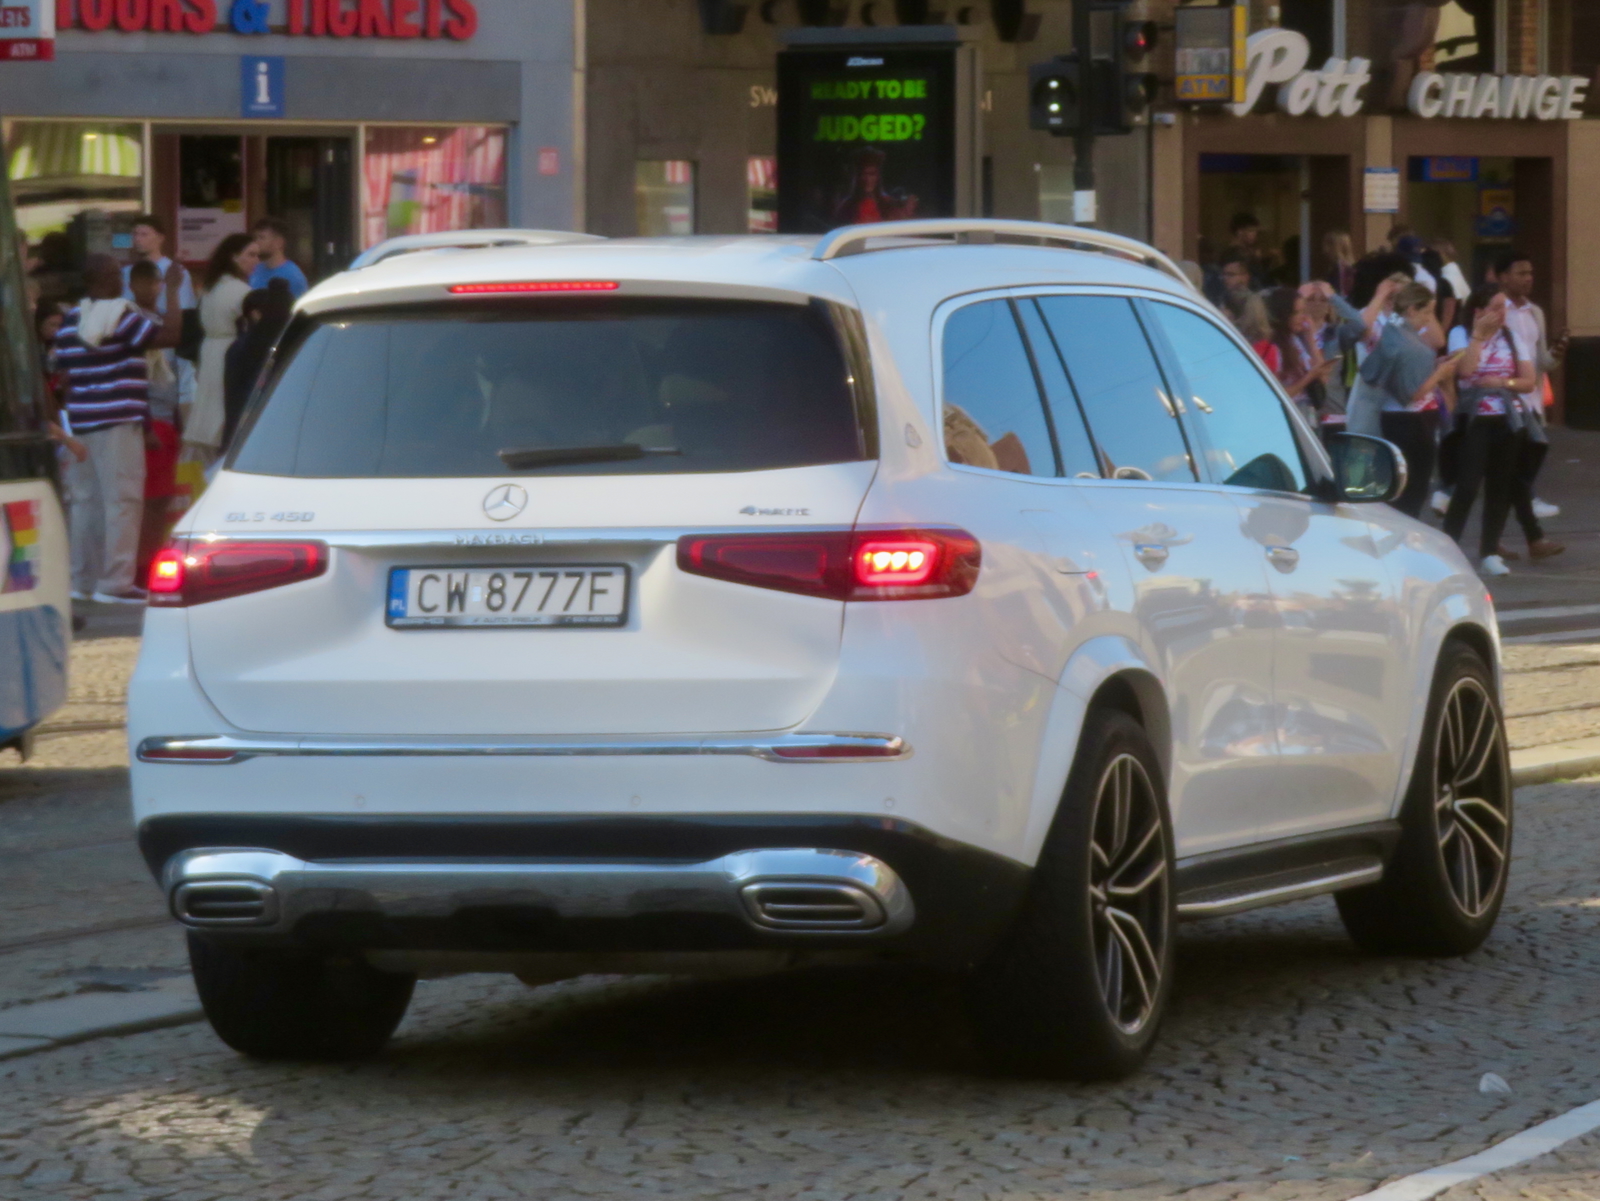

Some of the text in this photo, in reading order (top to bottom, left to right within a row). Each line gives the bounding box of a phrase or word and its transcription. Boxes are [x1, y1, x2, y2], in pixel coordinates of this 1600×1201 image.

[230, 0, 271, 34] &
[1179, 78, 1228, 94] ATM
[1228, 28, 1590, 119] Pott CHANGE
[811, 79, 927, 99] READY TO BE
[813, 114, 926, 141] JUDGED?
[270, 511, 316, 523] 450
[417, 571, 614, 614] CW 8777F
